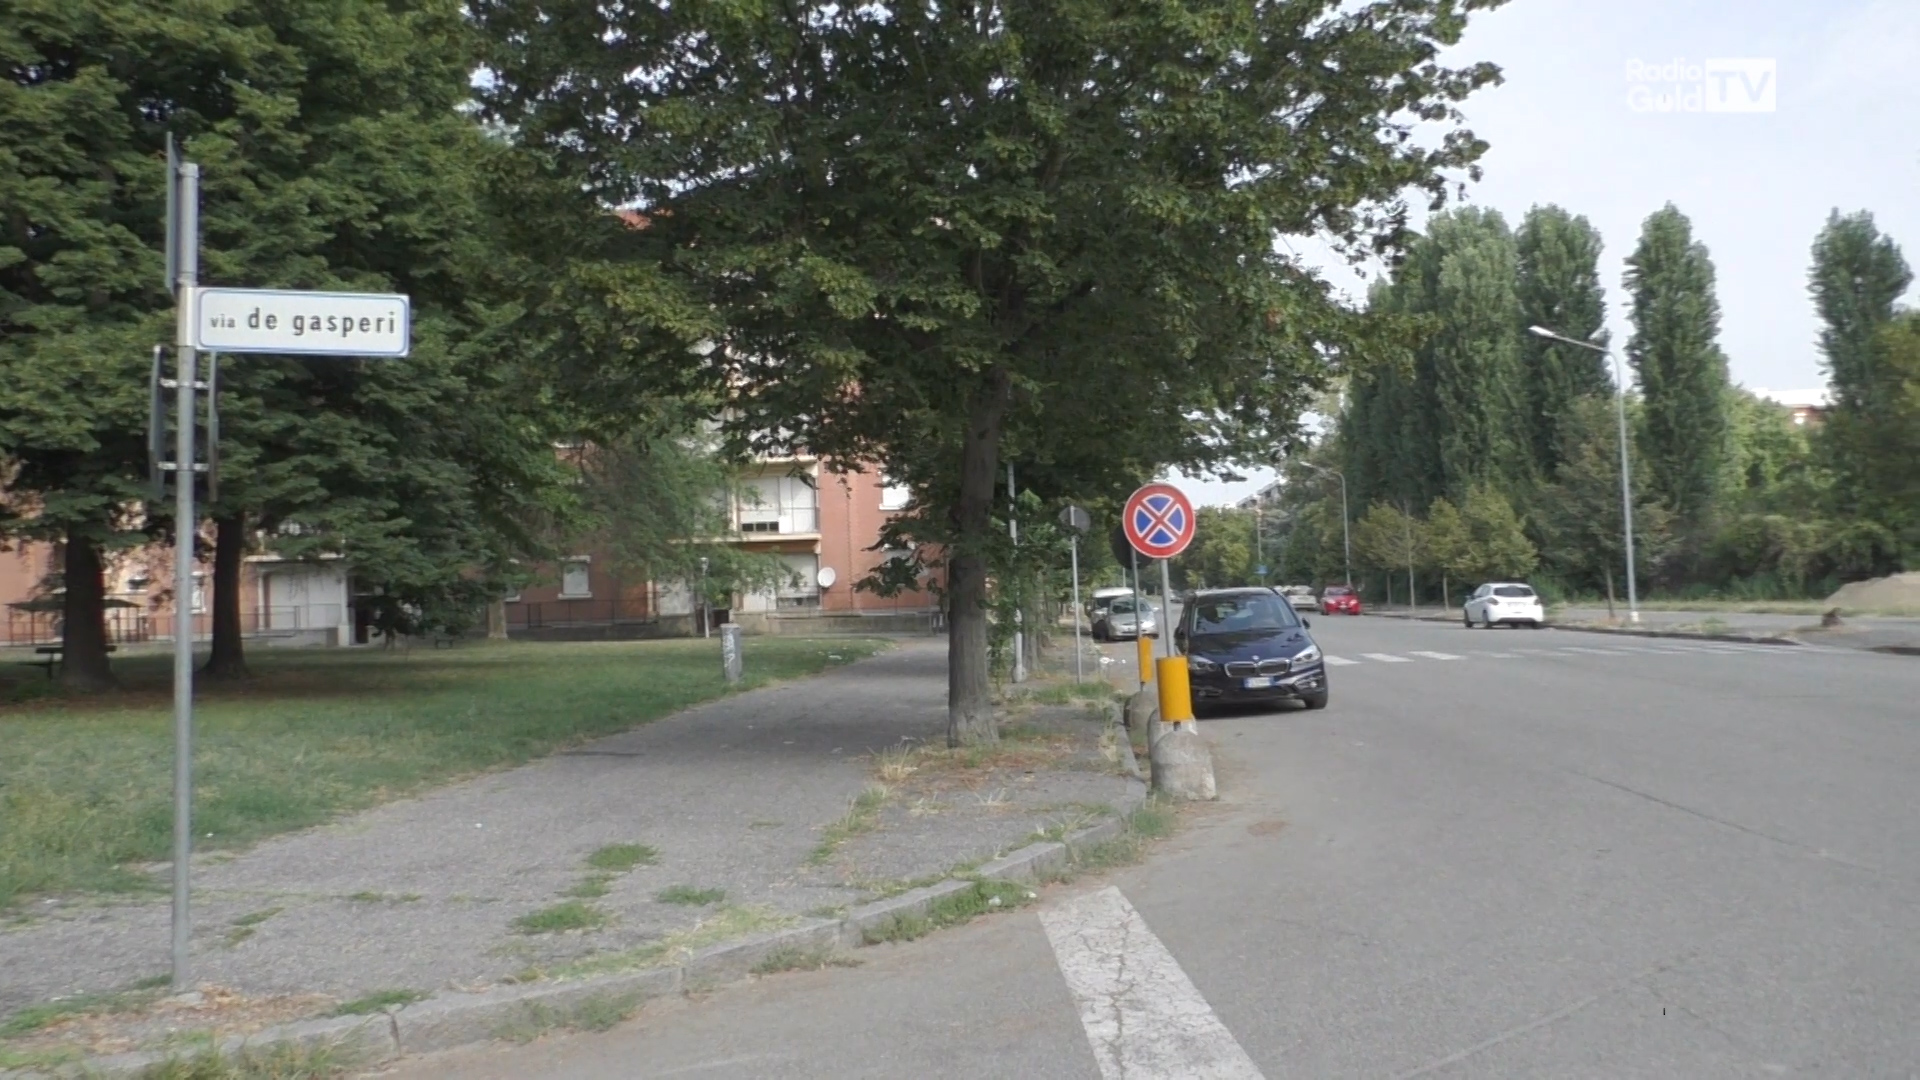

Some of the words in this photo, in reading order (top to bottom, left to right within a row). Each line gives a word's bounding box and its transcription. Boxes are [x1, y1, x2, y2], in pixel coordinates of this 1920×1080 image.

[210, 314, 236, 328] via
[248, 306, 278, 330] de
[293, 311, 396, 338] gasperi
